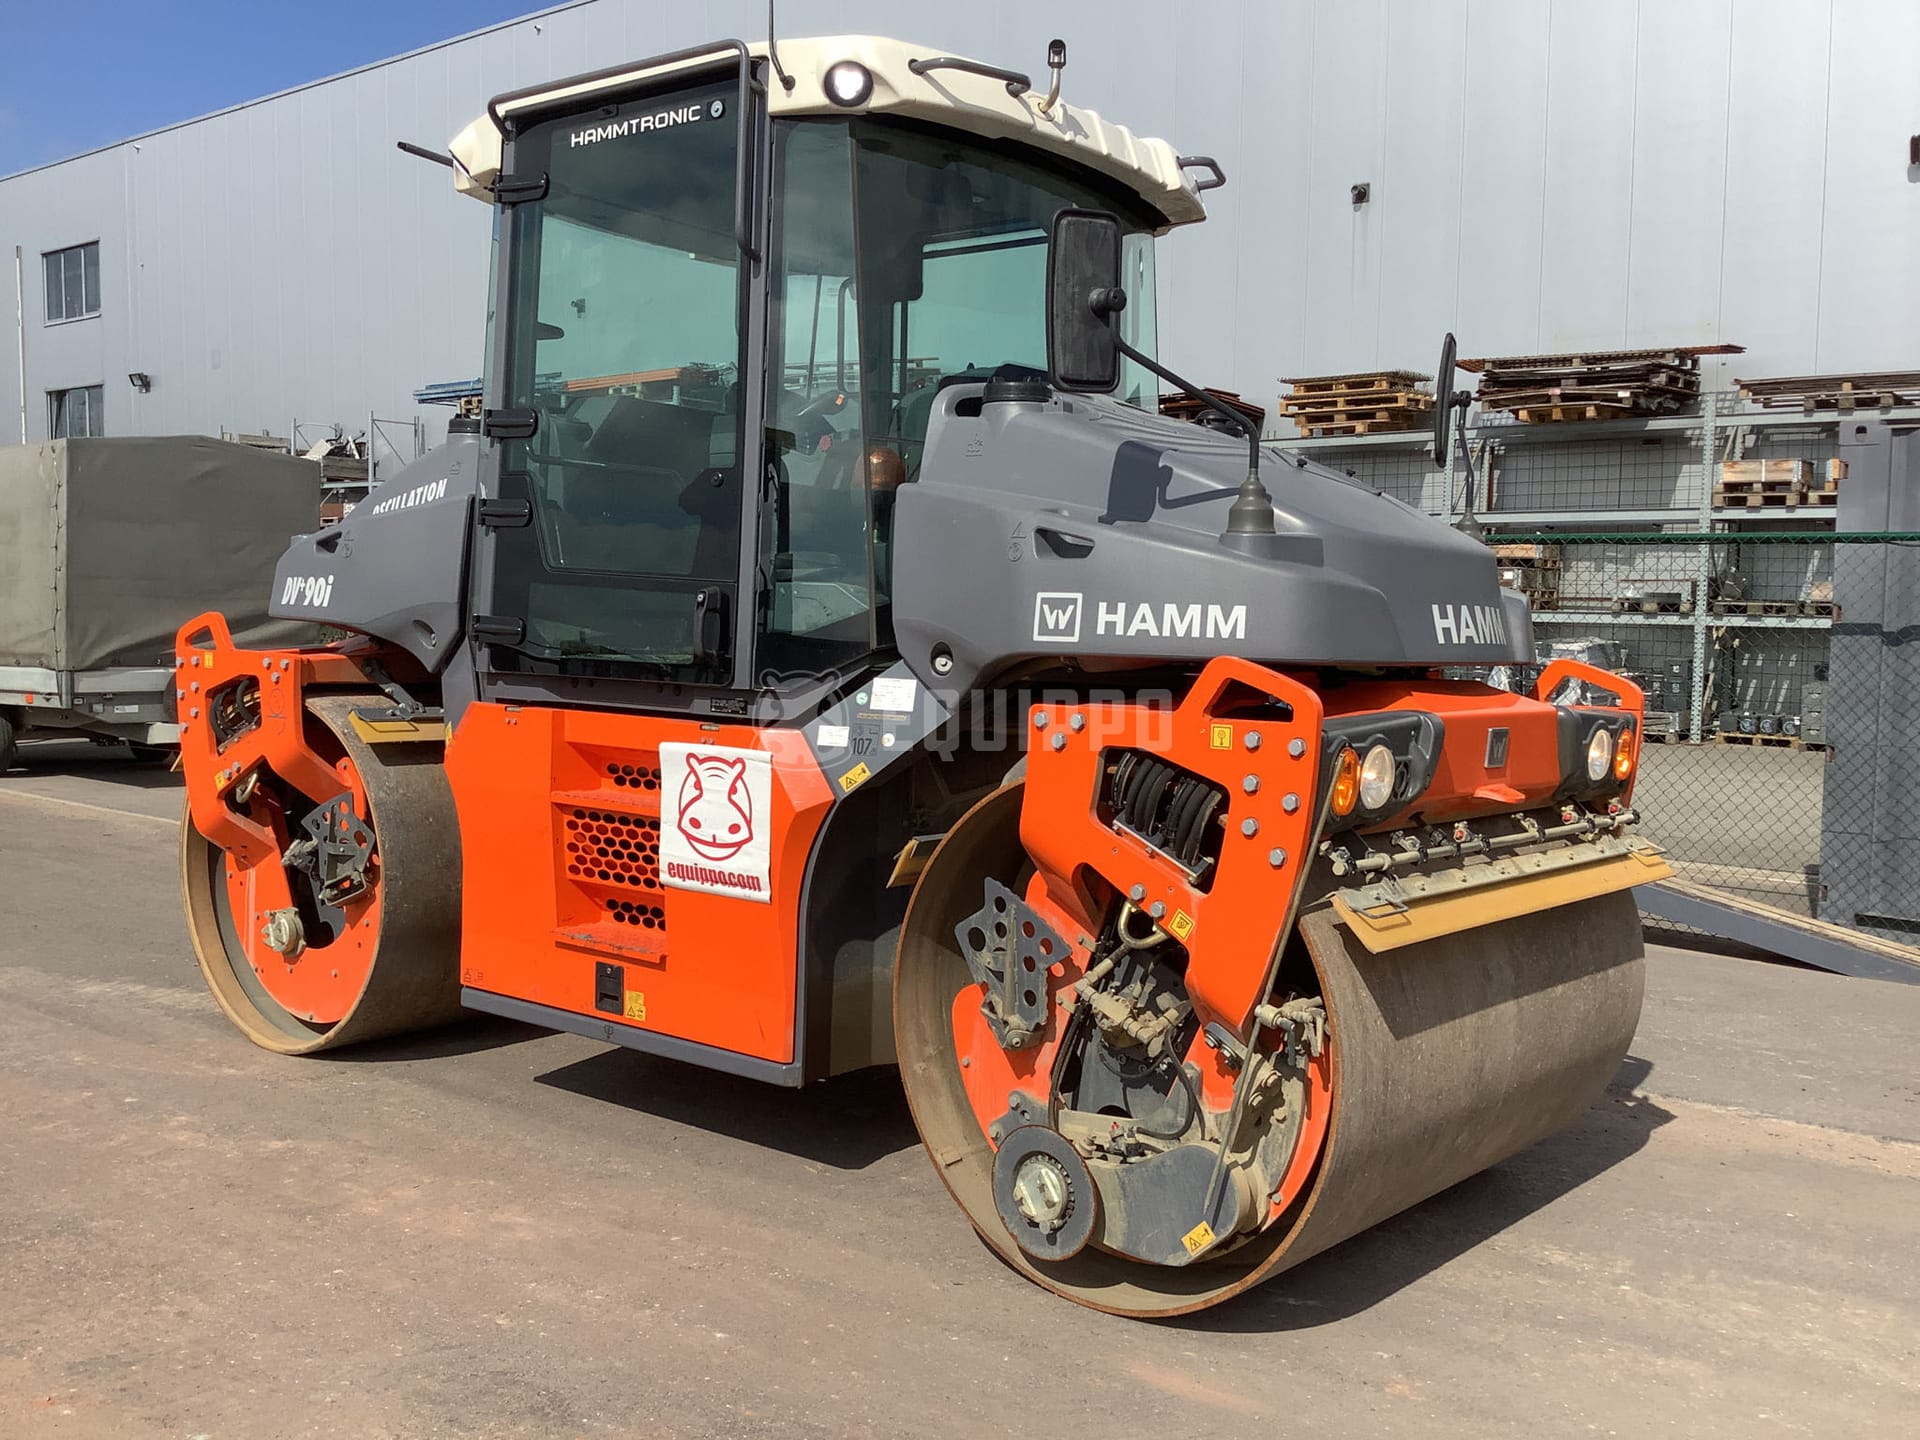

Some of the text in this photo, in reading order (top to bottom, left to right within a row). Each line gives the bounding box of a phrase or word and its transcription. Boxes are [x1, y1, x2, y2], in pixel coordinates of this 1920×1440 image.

[571, 105, 701, 147] HAMMTRONIC
[1096, 601, 1247, 640] HAMM
[853, 738, 872, 755] 107
[667, 861, 762, 892] equippo.com
